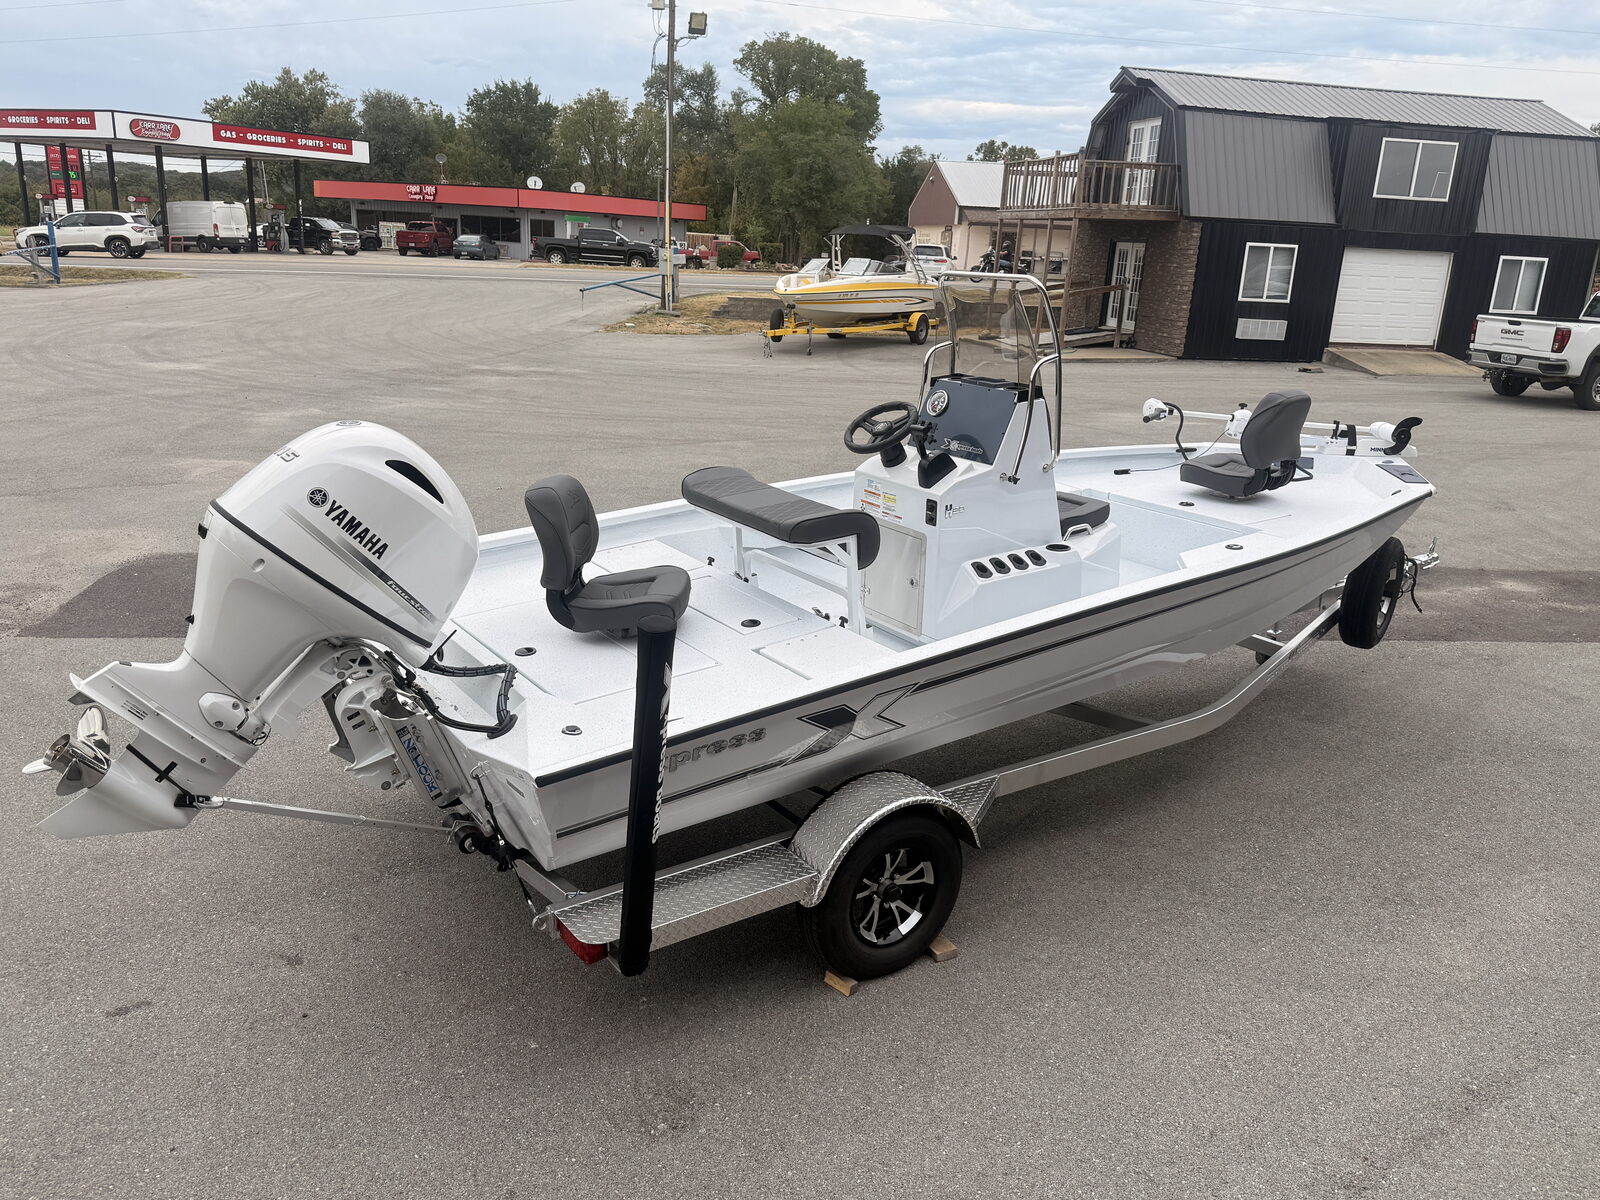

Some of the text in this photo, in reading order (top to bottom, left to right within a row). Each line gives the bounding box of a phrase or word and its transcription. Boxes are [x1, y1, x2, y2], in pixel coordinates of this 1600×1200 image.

[7, 115, 91, 125] GROCERIES SPIRITS DELI
[220, 129, 347, 151] GAS GROCERIES SPIRITS DELI
[406, 185, 421, 194] CARR
[1500, 328, 1525, 337] GMC
[324, 499, 390, 561] YAMAHA
[664, 727, 767, 773] press
